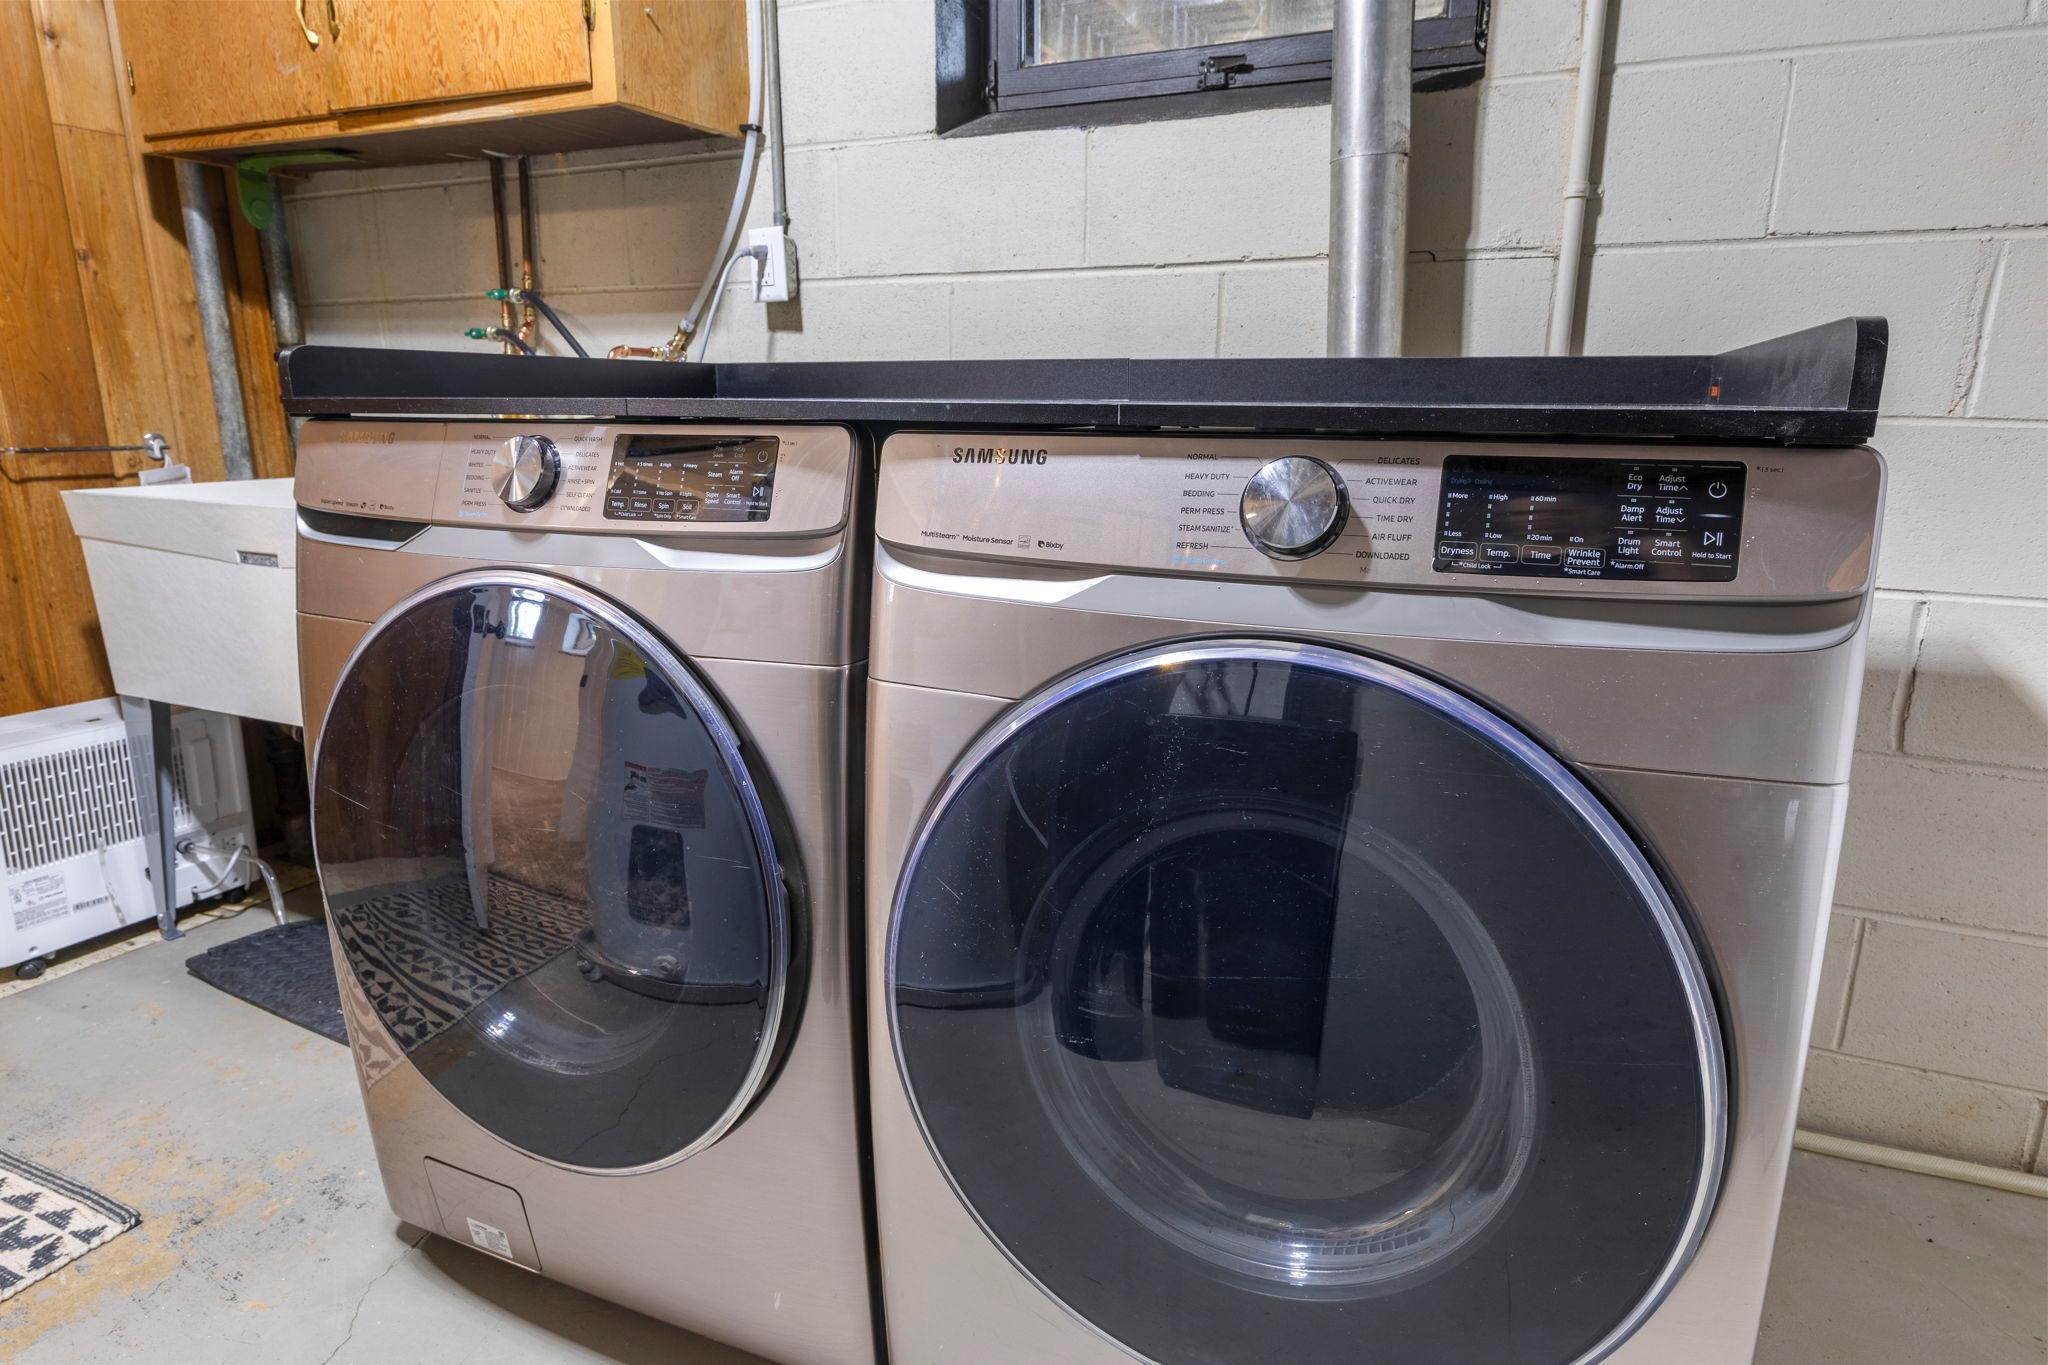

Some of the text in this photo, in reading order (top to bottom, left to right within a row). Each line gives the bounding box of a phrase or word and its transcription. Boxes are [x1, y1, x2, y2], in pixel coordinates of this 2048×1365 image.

[952, 447, 1048, 466] SAMSUNG
[1377, 457, 1421, 465] DELICATES
[1365, 477, 1418, 486] ACTIVEWEAR
[1628, 473, 1643, 481] Eco
[1659, 474, 1686, 483] Adjust
[1627, 483, 1643, 491] Dry
[1658, 483, 1679, 492] Time
[1182, 490, 1215, 498] BEDDING
[1493, 493, 1509, 502] High
[1373, 496, 1416, 505] QUICK DRY
[1180, 507, 1225, 515] PERM PRESS
[1620, 505, 1645, 514] Damp
[1655, 506, 1684, 516] Adjust
[1376, 514, 1414, 523] TIME DRY
[1621, 514, 1643, 522] Alert
[1655, 515, 1676, 524] Time
[1178, 524, 1201, 532] STEAM
[962, 535, 1014, 545] Moisture Sensor
[1371, 533, 1412, 542] AIR FLUFF
[1617, 537, 1641, 545] Drum
[1045, 541, 1064, 550] Bixby
[1176, 542, 1209, 550] REFRESH
[1654, 538, 1681, 548] Smart
[1441, 546, 1474, 556] Dryness
[1486, 548, 1511, 559] Temp.
[1530, 550, 1552, 560] Time
[1568, 548, 1601, 558] Wrinkle
[1618, 546, 1639, 555] Light
[1651, 548, 1682, 557] Control
[1355, 551, 1410, 561] DOWNLOADED
[1716, 552, 1732, 560] Start
[1567, 557, 1601, 567] Prevent
